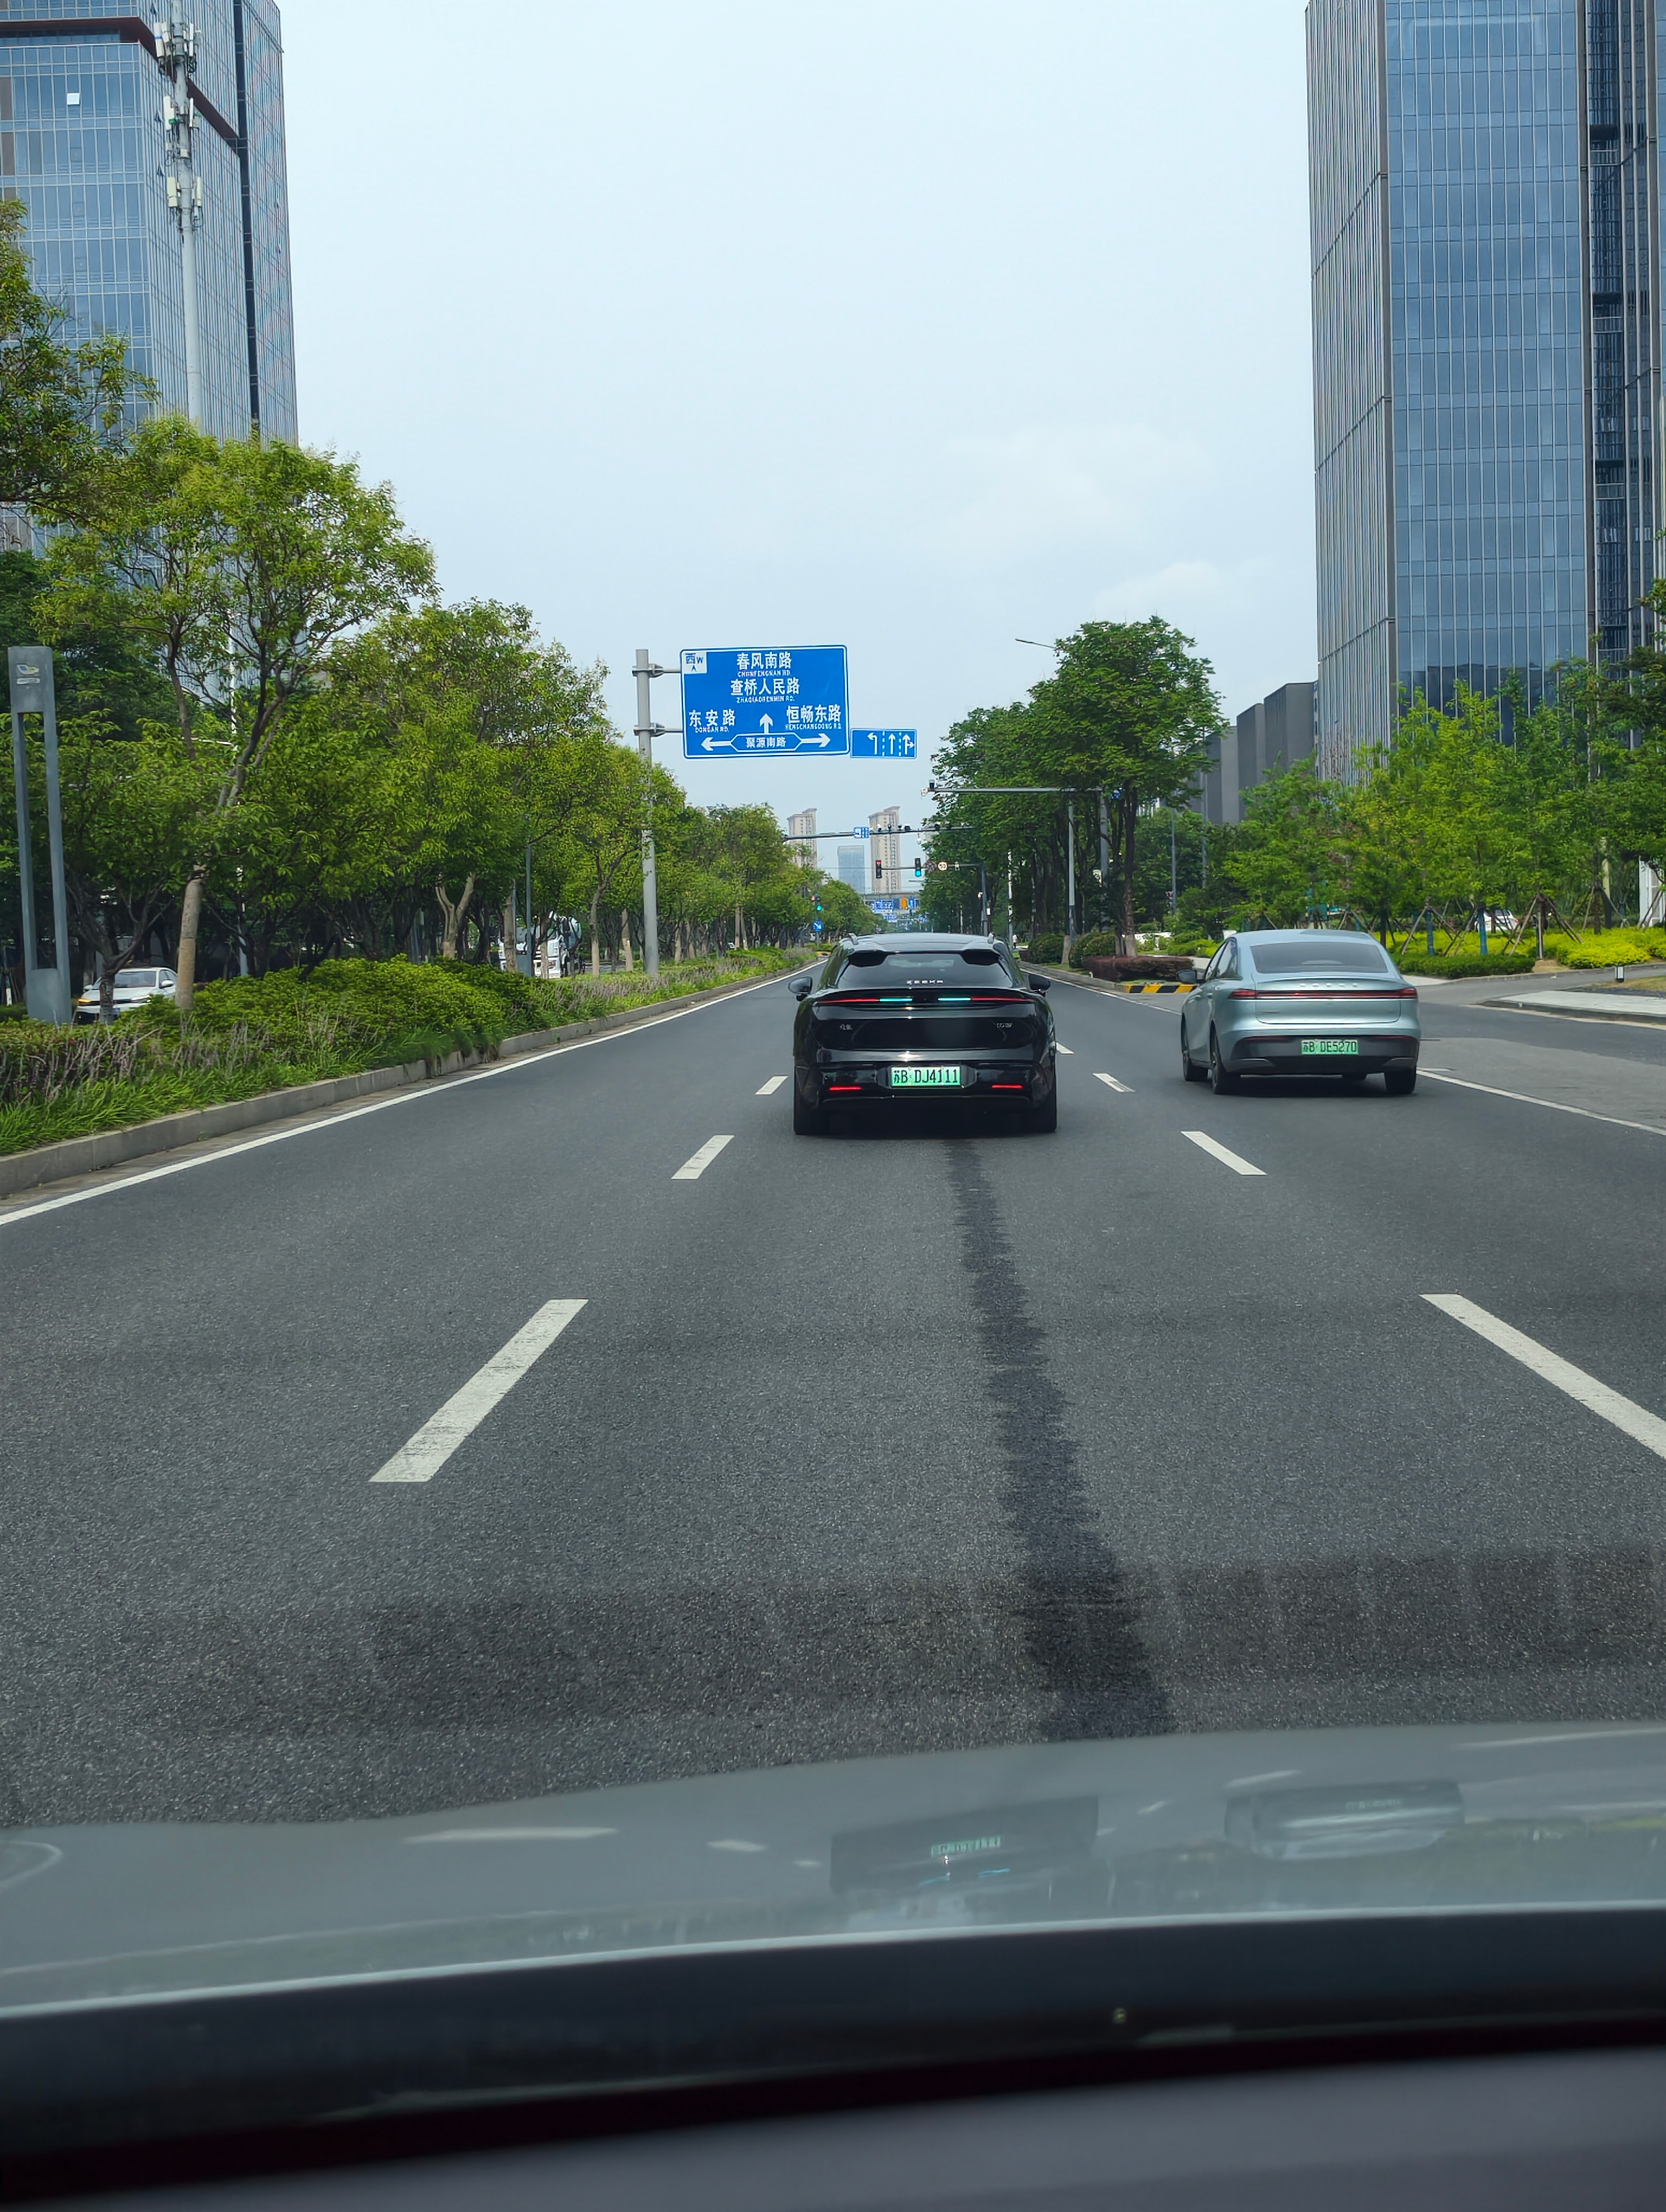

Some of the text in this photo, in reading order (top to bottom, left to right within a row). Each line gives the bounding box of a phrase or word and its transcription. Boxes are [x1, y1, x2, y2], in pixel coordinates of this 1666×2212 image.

[685, 653, 696, 664] 西
[736, 651, 792, 670] 春风南路
[731, 677, 799, 696] 查桥人民路
[689, 709, 735, 726] 东安路
[786, 704, 841, 724] 恒畅东路
